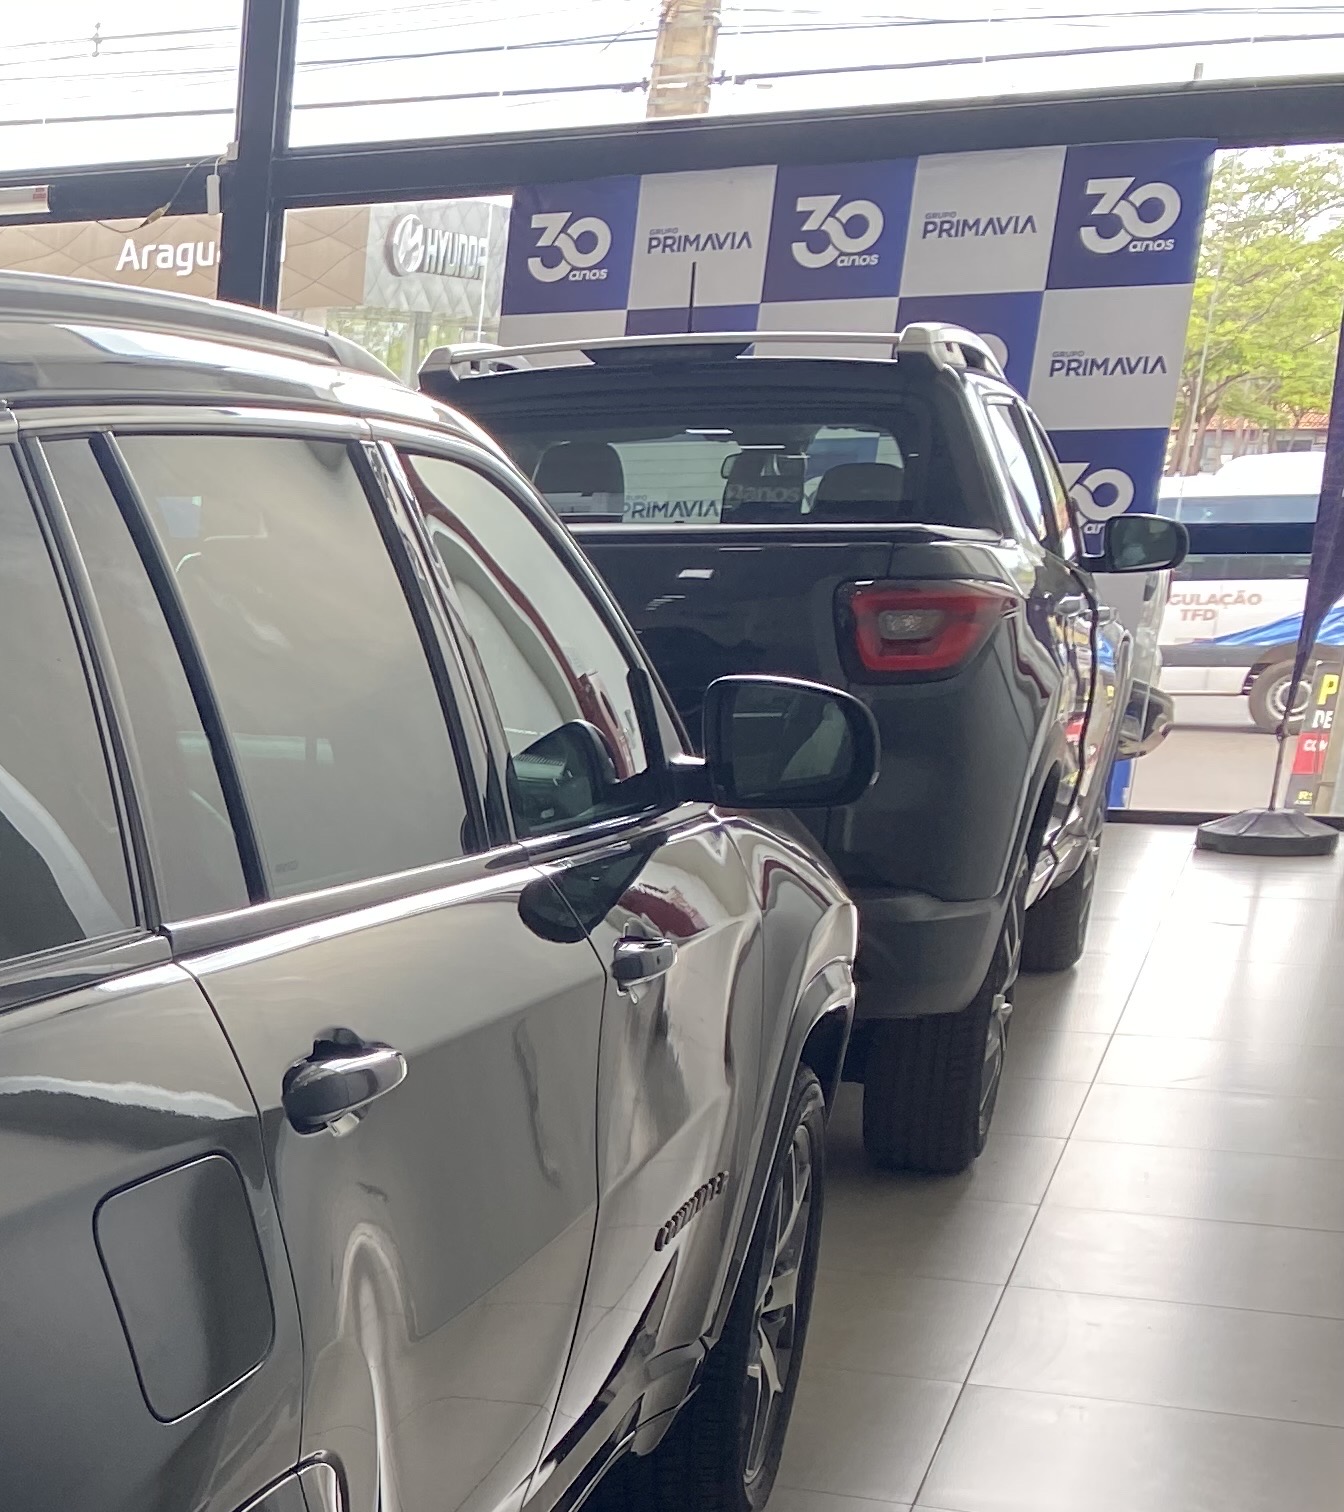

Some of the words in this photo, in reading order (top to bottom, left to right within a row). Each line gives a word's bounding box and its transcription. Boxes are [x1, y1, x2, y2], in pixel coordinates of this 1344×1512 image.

[925, 211, 957, 220] GRUPO
[1080, 177, 1181, 253] 30
[649, 227, 678, 235] GRUPO
[791, 194, 884, 268] 30
[922, 215, 1037, 239] PRIMAVIA
[527, 211, 612, 282] 30
[647, 231, 752, 254] PRIMAVIA
[1128, 238, 1175, 252] anos
[115, 239, 220, 276] Aragu
[423, 228, 488, 280] HYUNDA
[837, 253, 879, 267] anos
[568, 268, 608, 281] anos
[1049, 355, 1167, 377] PRIMAVIA
[1169, 590, 1263, 609] GULAÇÃO
[1180, 608, 1216, 621] TFD
